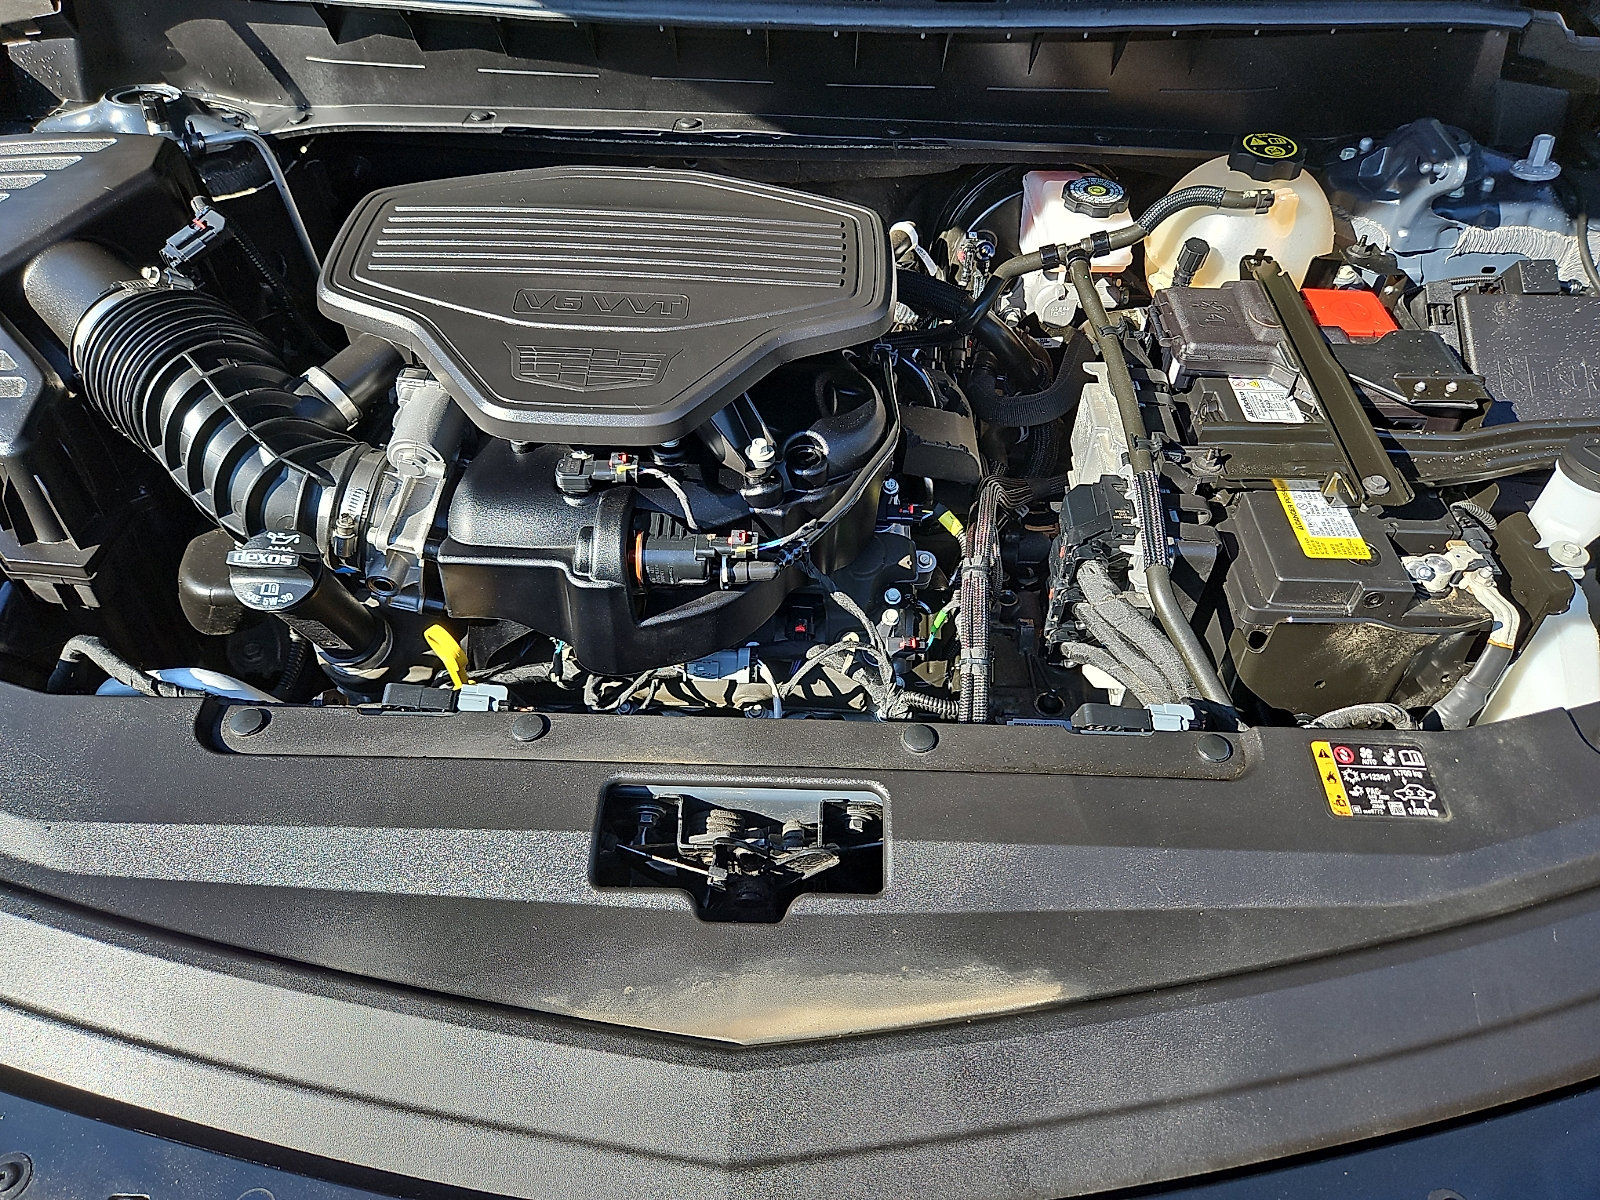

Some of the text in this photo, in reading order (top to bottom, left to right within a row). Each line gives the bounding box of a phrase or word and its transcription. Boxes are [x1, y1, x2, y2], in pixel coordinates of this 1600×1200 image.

[522, 292, 683, 315] V6 VVT
[233, 551, 296, 565] dexos
[244, 591, 294, 606] SAE 5W-30
